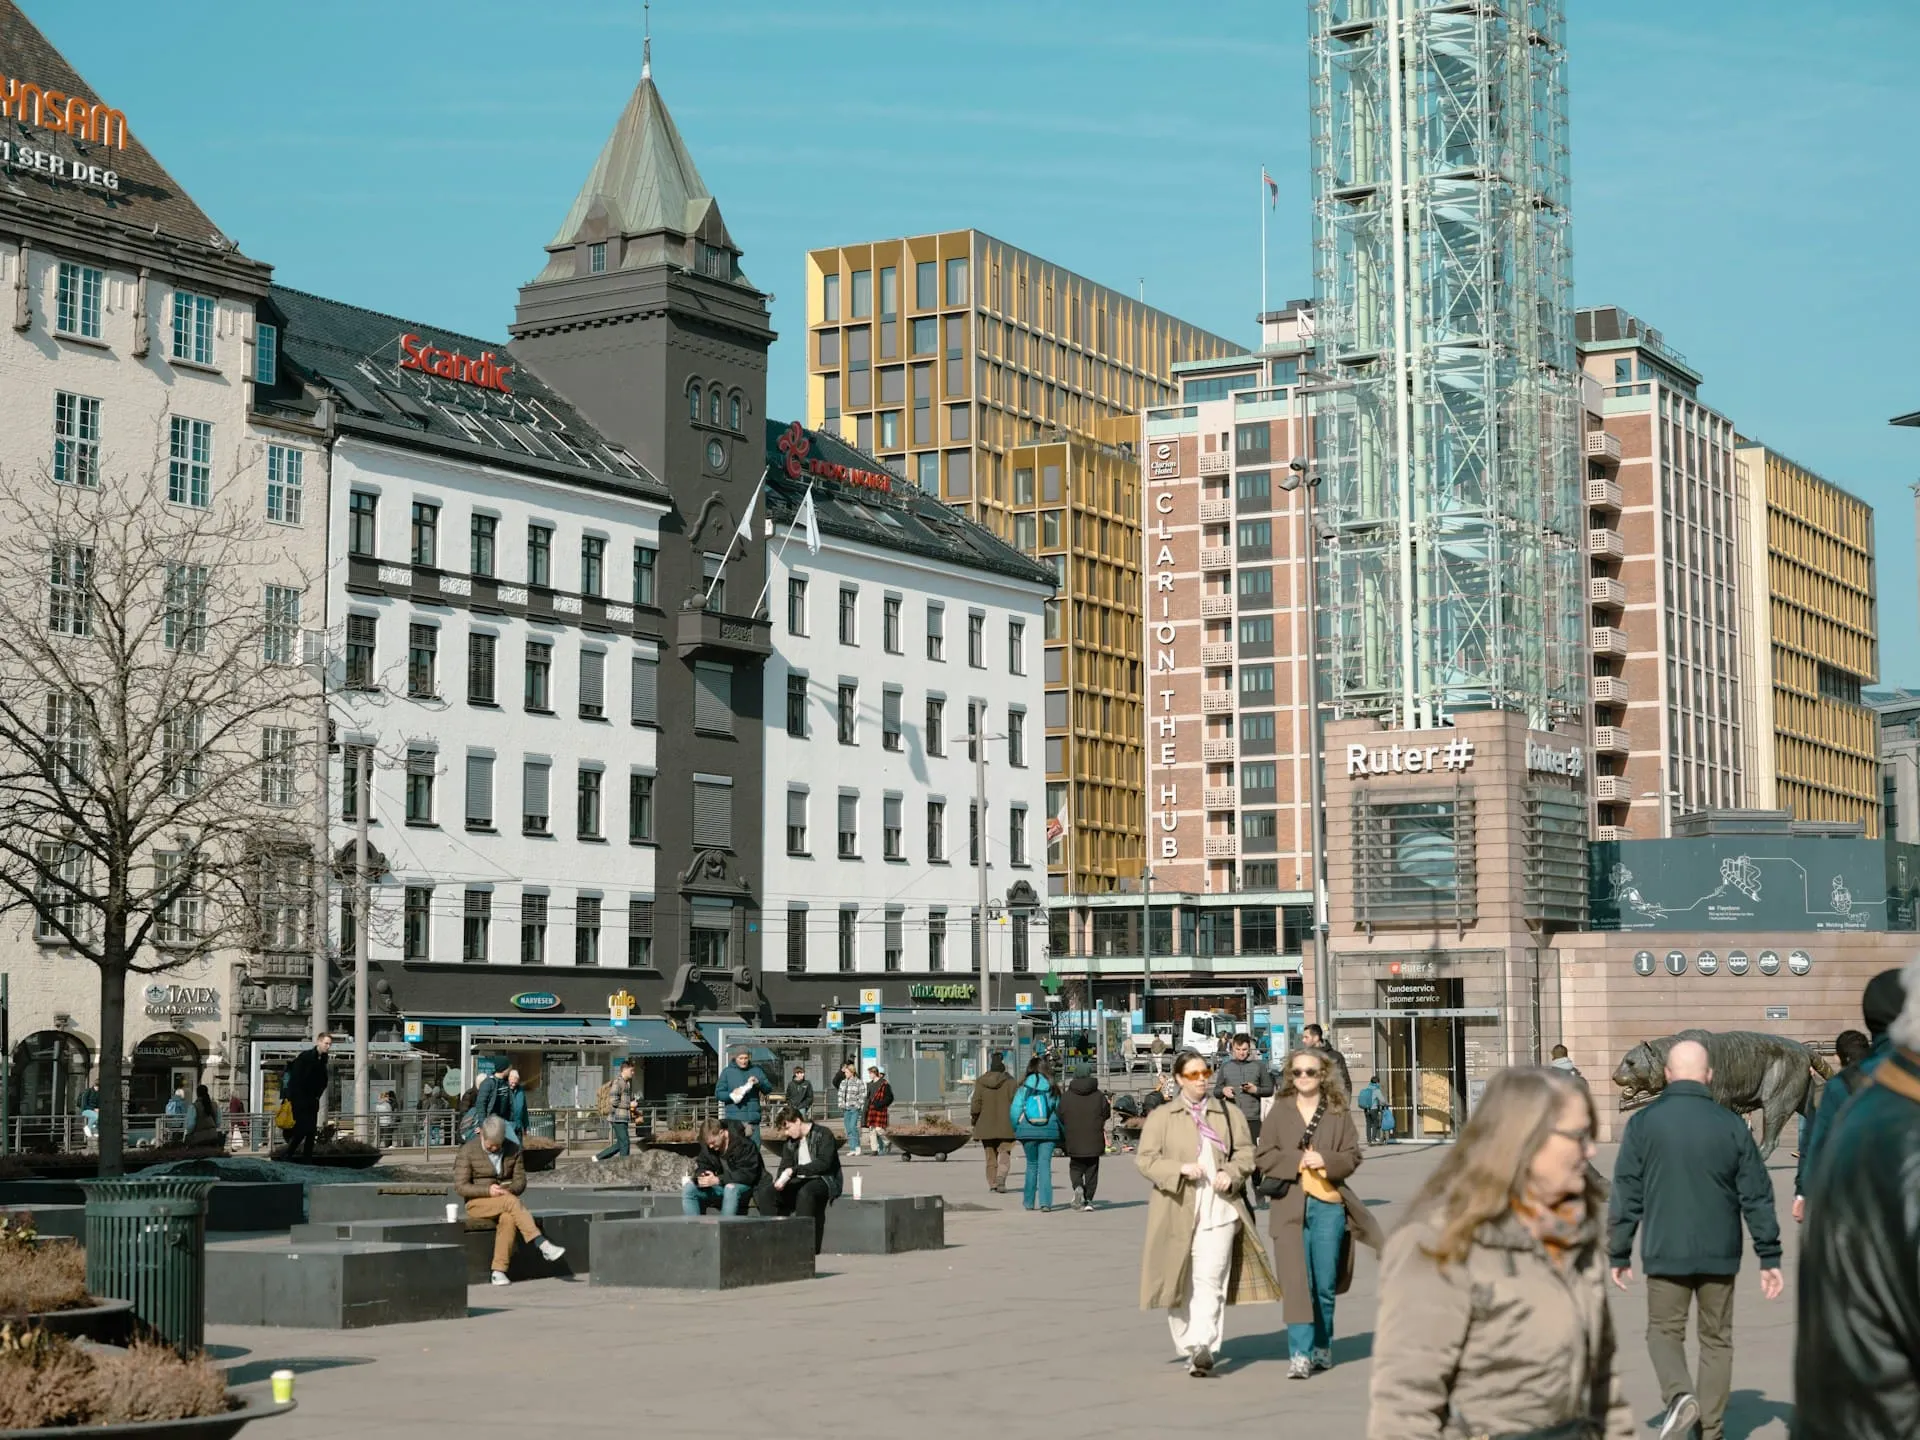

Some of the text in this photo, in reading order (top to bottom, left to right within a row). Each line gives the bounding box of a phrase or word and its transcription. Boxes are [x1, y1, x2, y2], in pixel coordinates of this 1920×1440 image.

[19, 147, 64, 175] SER
[72, 161, 119, 190] DEG
[400, 333, 512, 396] Scandic
[1156, 492, 1178, 858] CLARION THE HUB
[1401, 962, 1425, 973] Ruter
[1387, 984, 1435, 993] Kundeservice
[520, 997, 554, 1005] NARVESEN
[1415, 995, 1440, 1003] service
